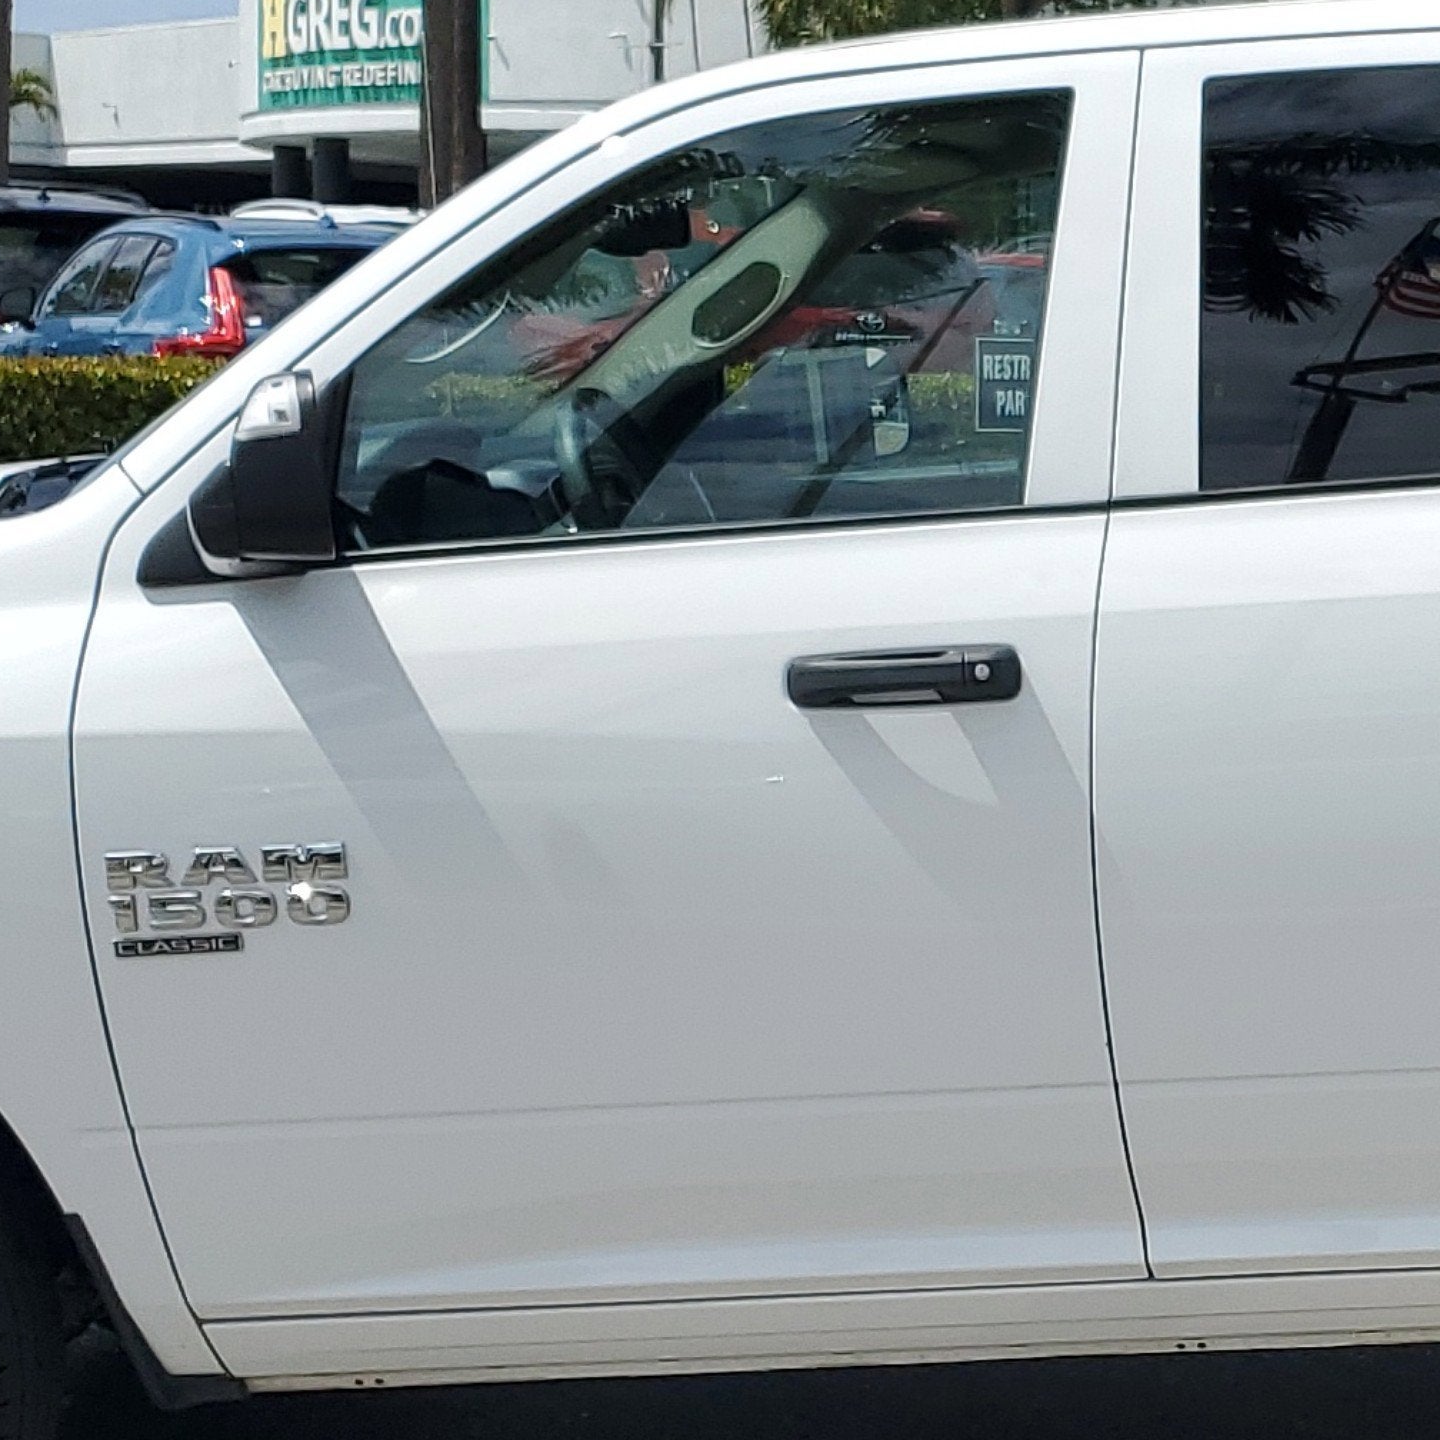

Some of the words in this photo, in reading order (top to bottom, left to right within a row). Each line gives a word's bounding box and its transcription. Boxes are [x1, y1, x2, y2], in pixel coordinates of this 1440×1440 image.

[342, 60, 422, 87] REDEFIN
[982, 353, 1031, 382] RESTR
[995, 389, 1026, 417] PAR
[104, 841, 348, 891] RAM
[107, 881, 351, 933] 1500
[116, 935, 239, 956] CLASSIC
